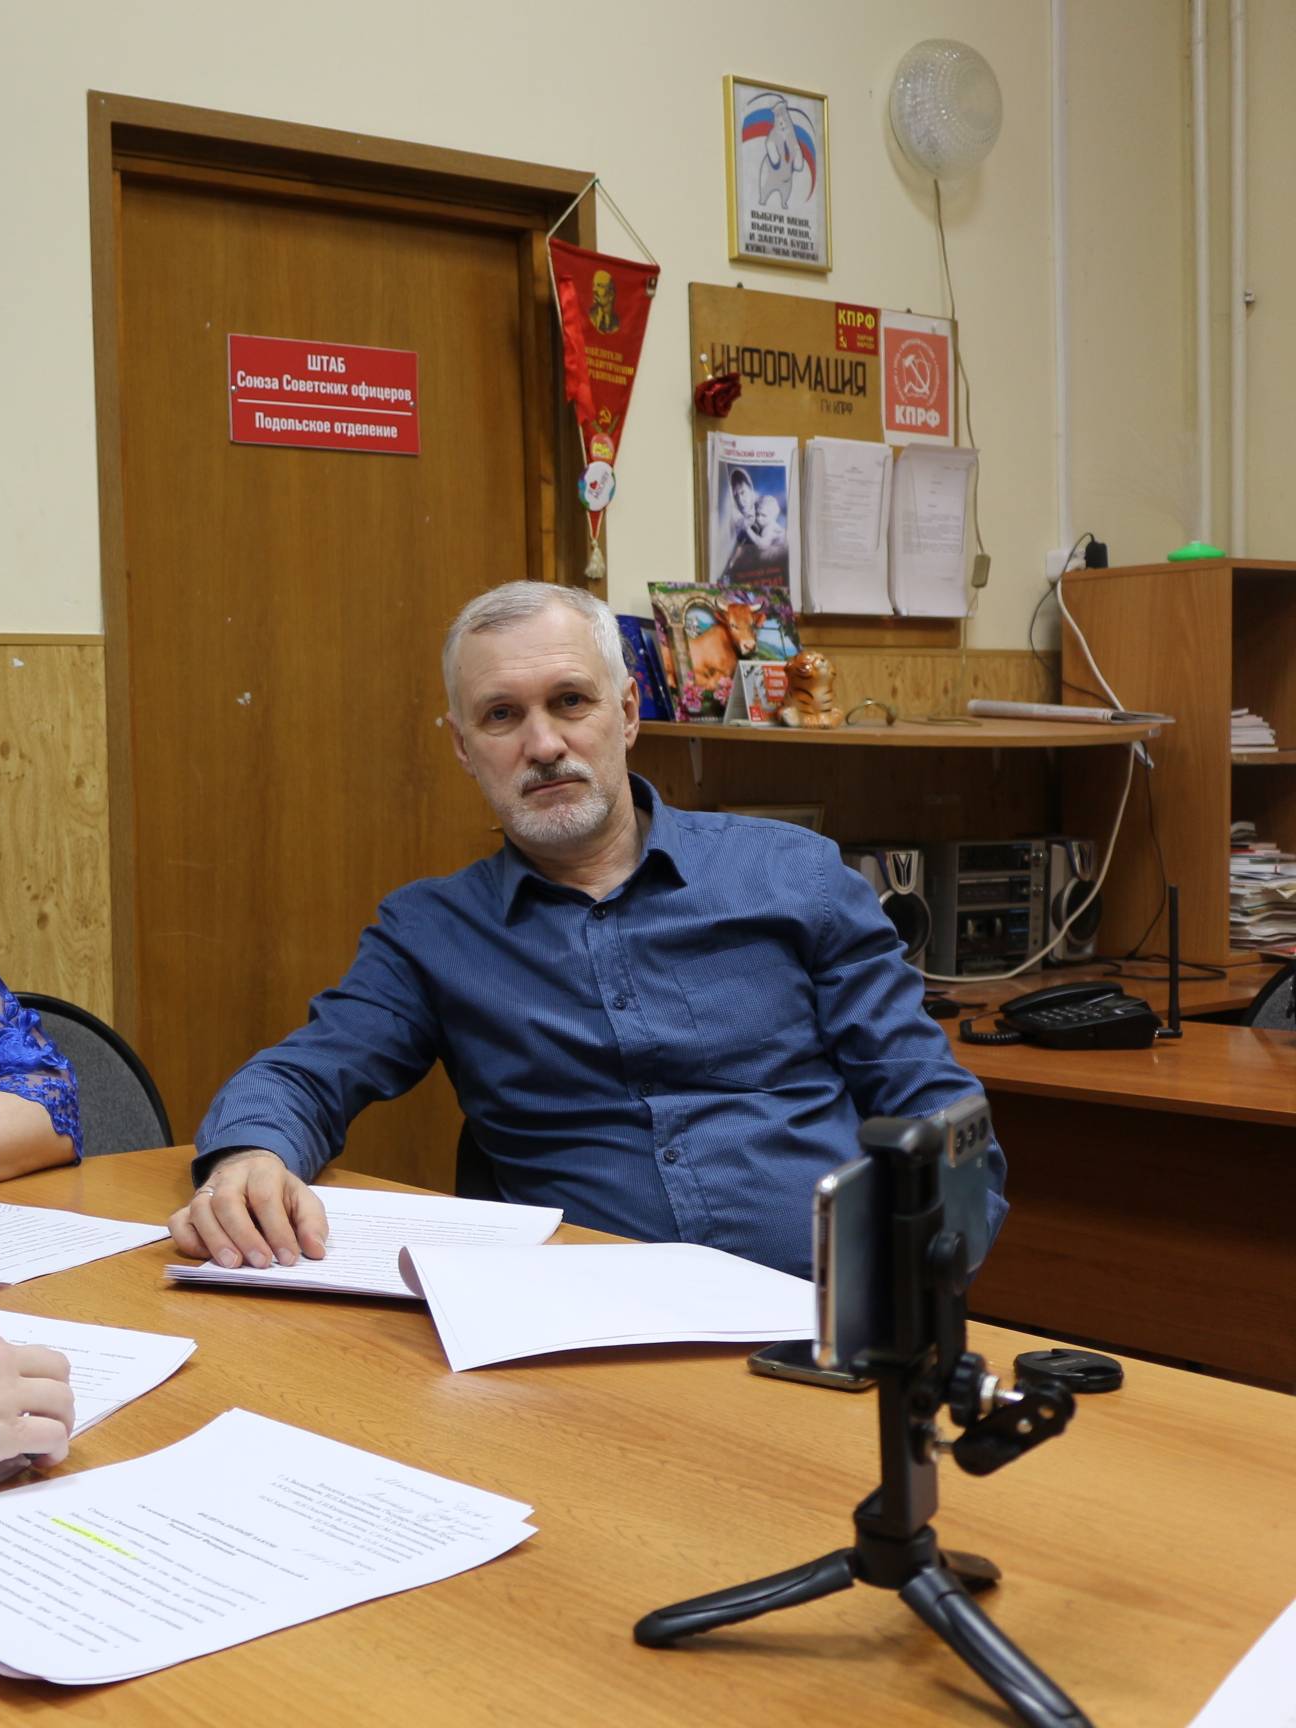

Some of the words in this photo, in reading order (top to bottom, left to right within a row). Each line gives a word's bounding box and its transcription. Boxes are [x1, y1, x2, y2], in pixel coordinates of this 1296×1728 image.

[758, 233, 788, 246] ЗАВТРА
[838, 308, 875, 329] КПРФ
[307, 354, 346, 373] ШТАБ
[711, 342, 867, 398] ИНФОРМАЦИЯ
[236, 370, 279, 390] Союза
[283, 374, 348, 396] Советских
[351, 381, 412, 403] офицеров
[255, 411, 331, 433] Подольское
[334, 420, 398, 439] отделение
[895, 404, 941, 428] КПРФ
